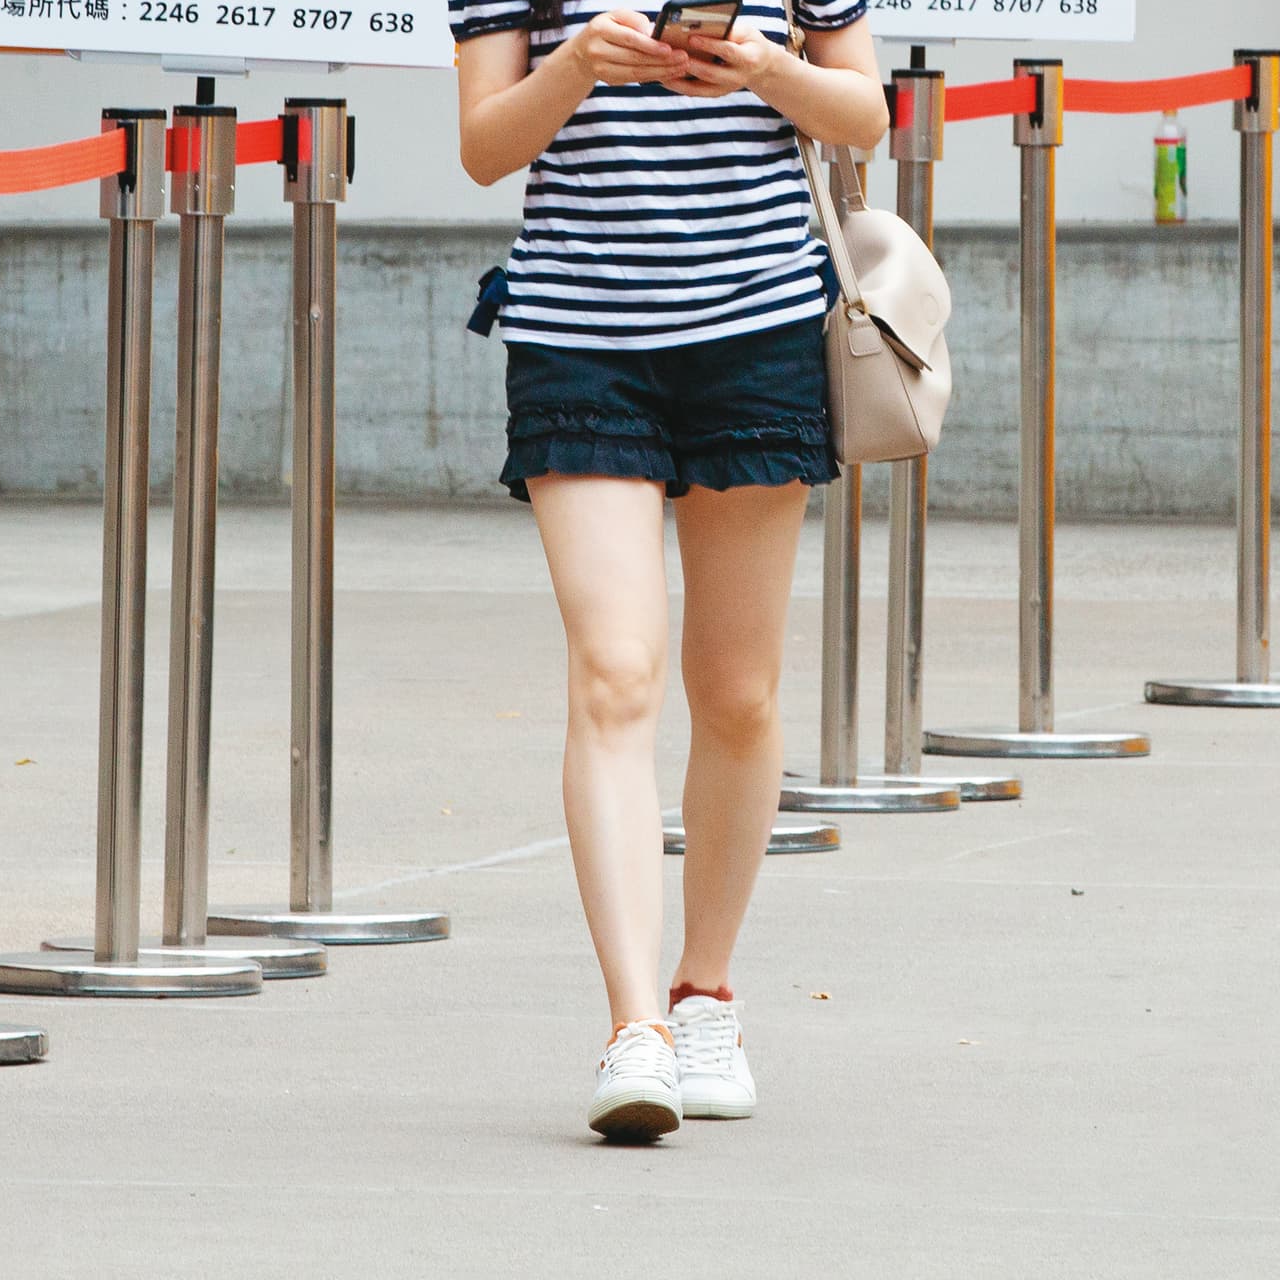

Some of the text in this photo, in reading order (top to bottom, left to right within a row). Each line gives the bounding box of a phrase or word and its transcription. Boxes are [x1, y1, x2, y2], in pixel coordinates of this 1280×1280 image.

[139, 1, 199, 24] 2246
[215, 4, 276, 27] 2617
[292, 8, 353, 31] 8707
[369, 12, 414, 34] 638
